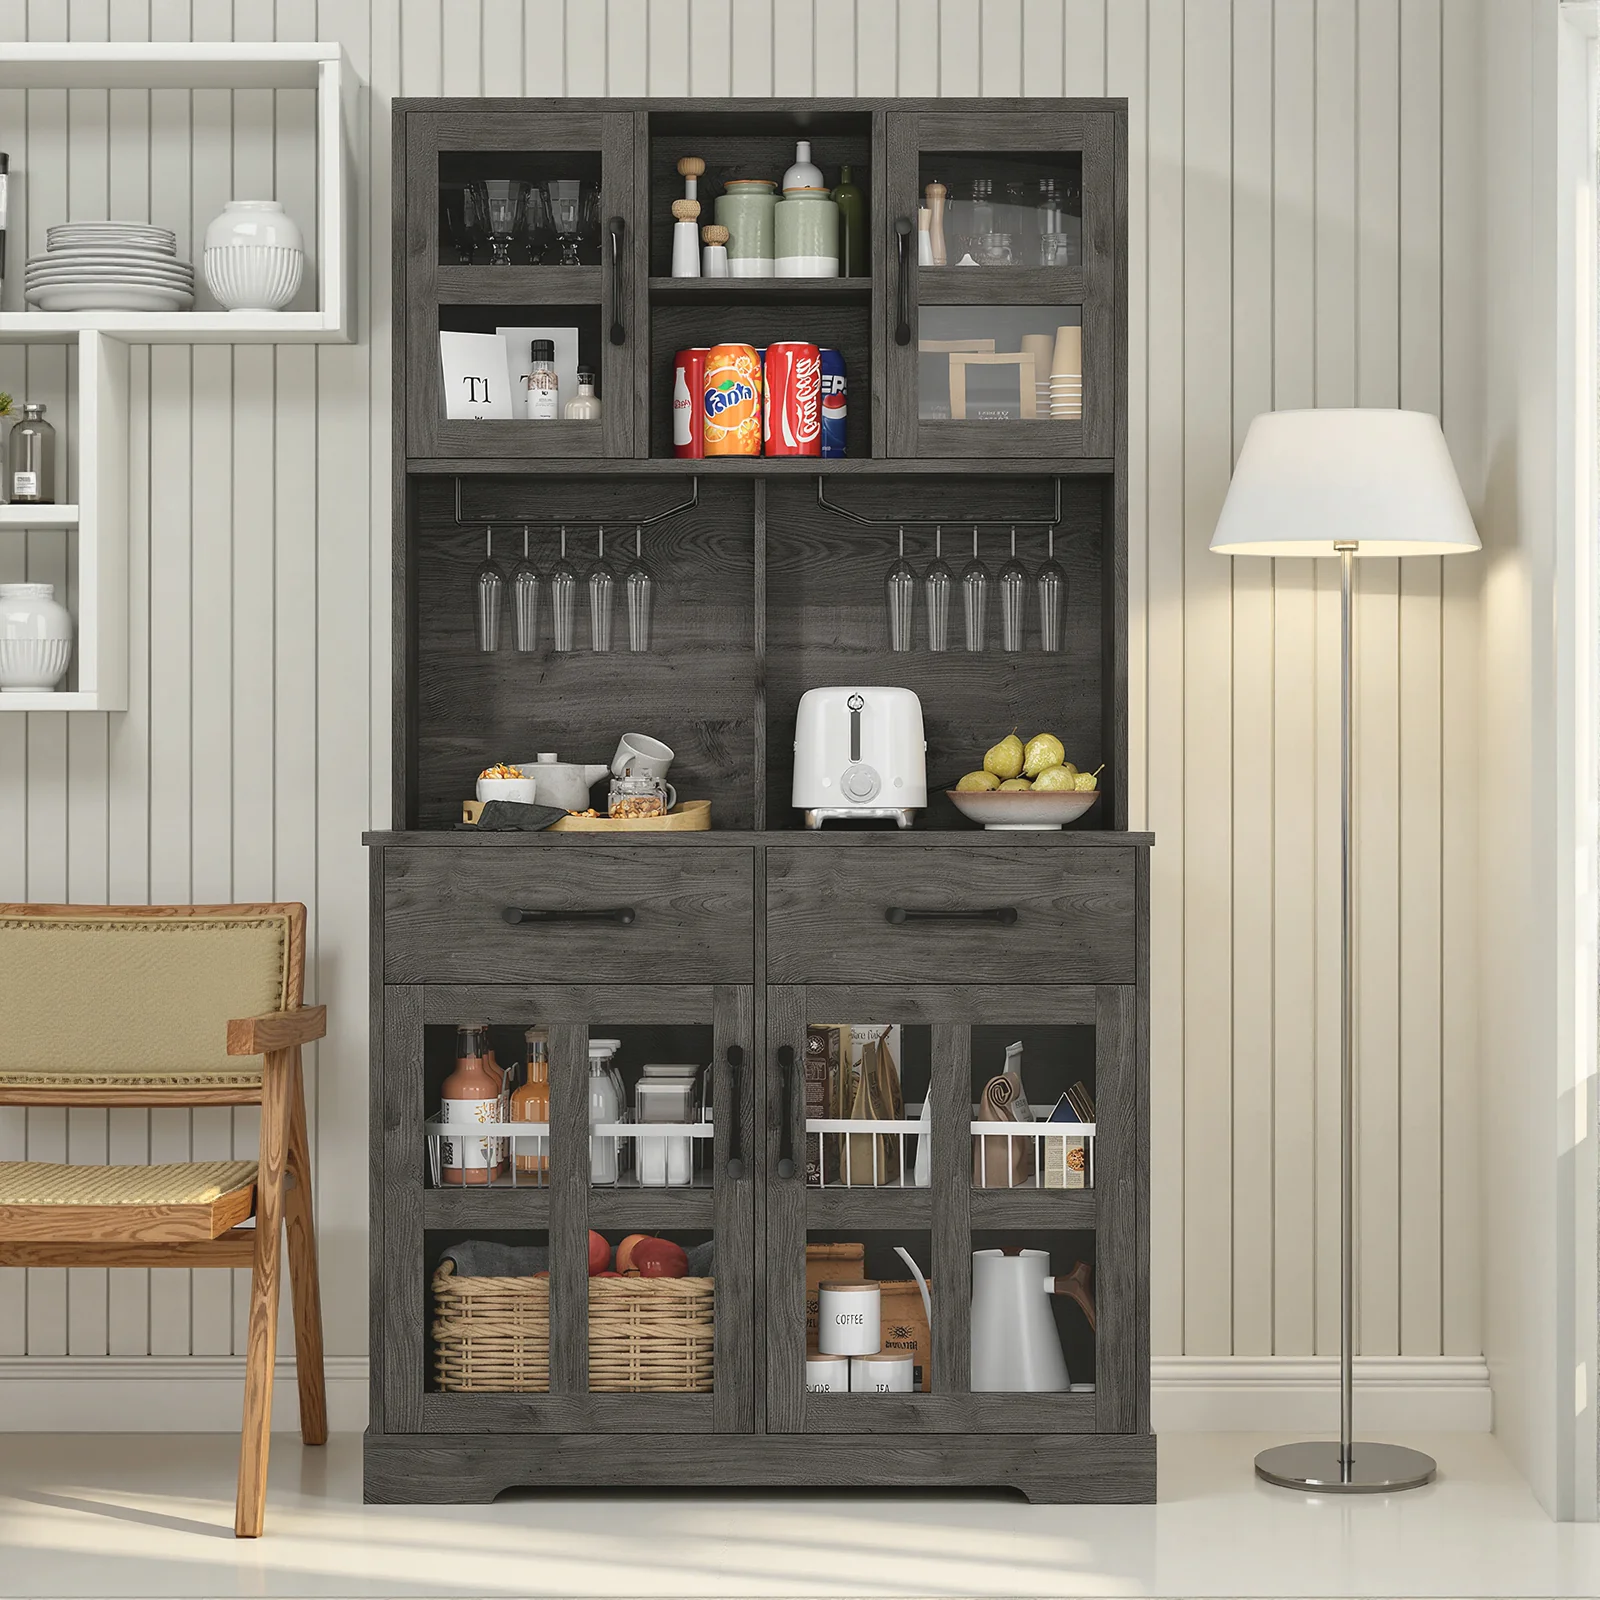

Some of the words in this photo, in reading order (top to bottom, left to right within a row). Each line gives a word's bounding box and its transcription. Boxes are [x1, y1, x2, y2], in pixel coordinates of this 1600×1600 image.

[462, 376, 492, 404] T1
[704, 382, 753, 417] Fanta
[835, 1314, 864, 1325] COFFEE
